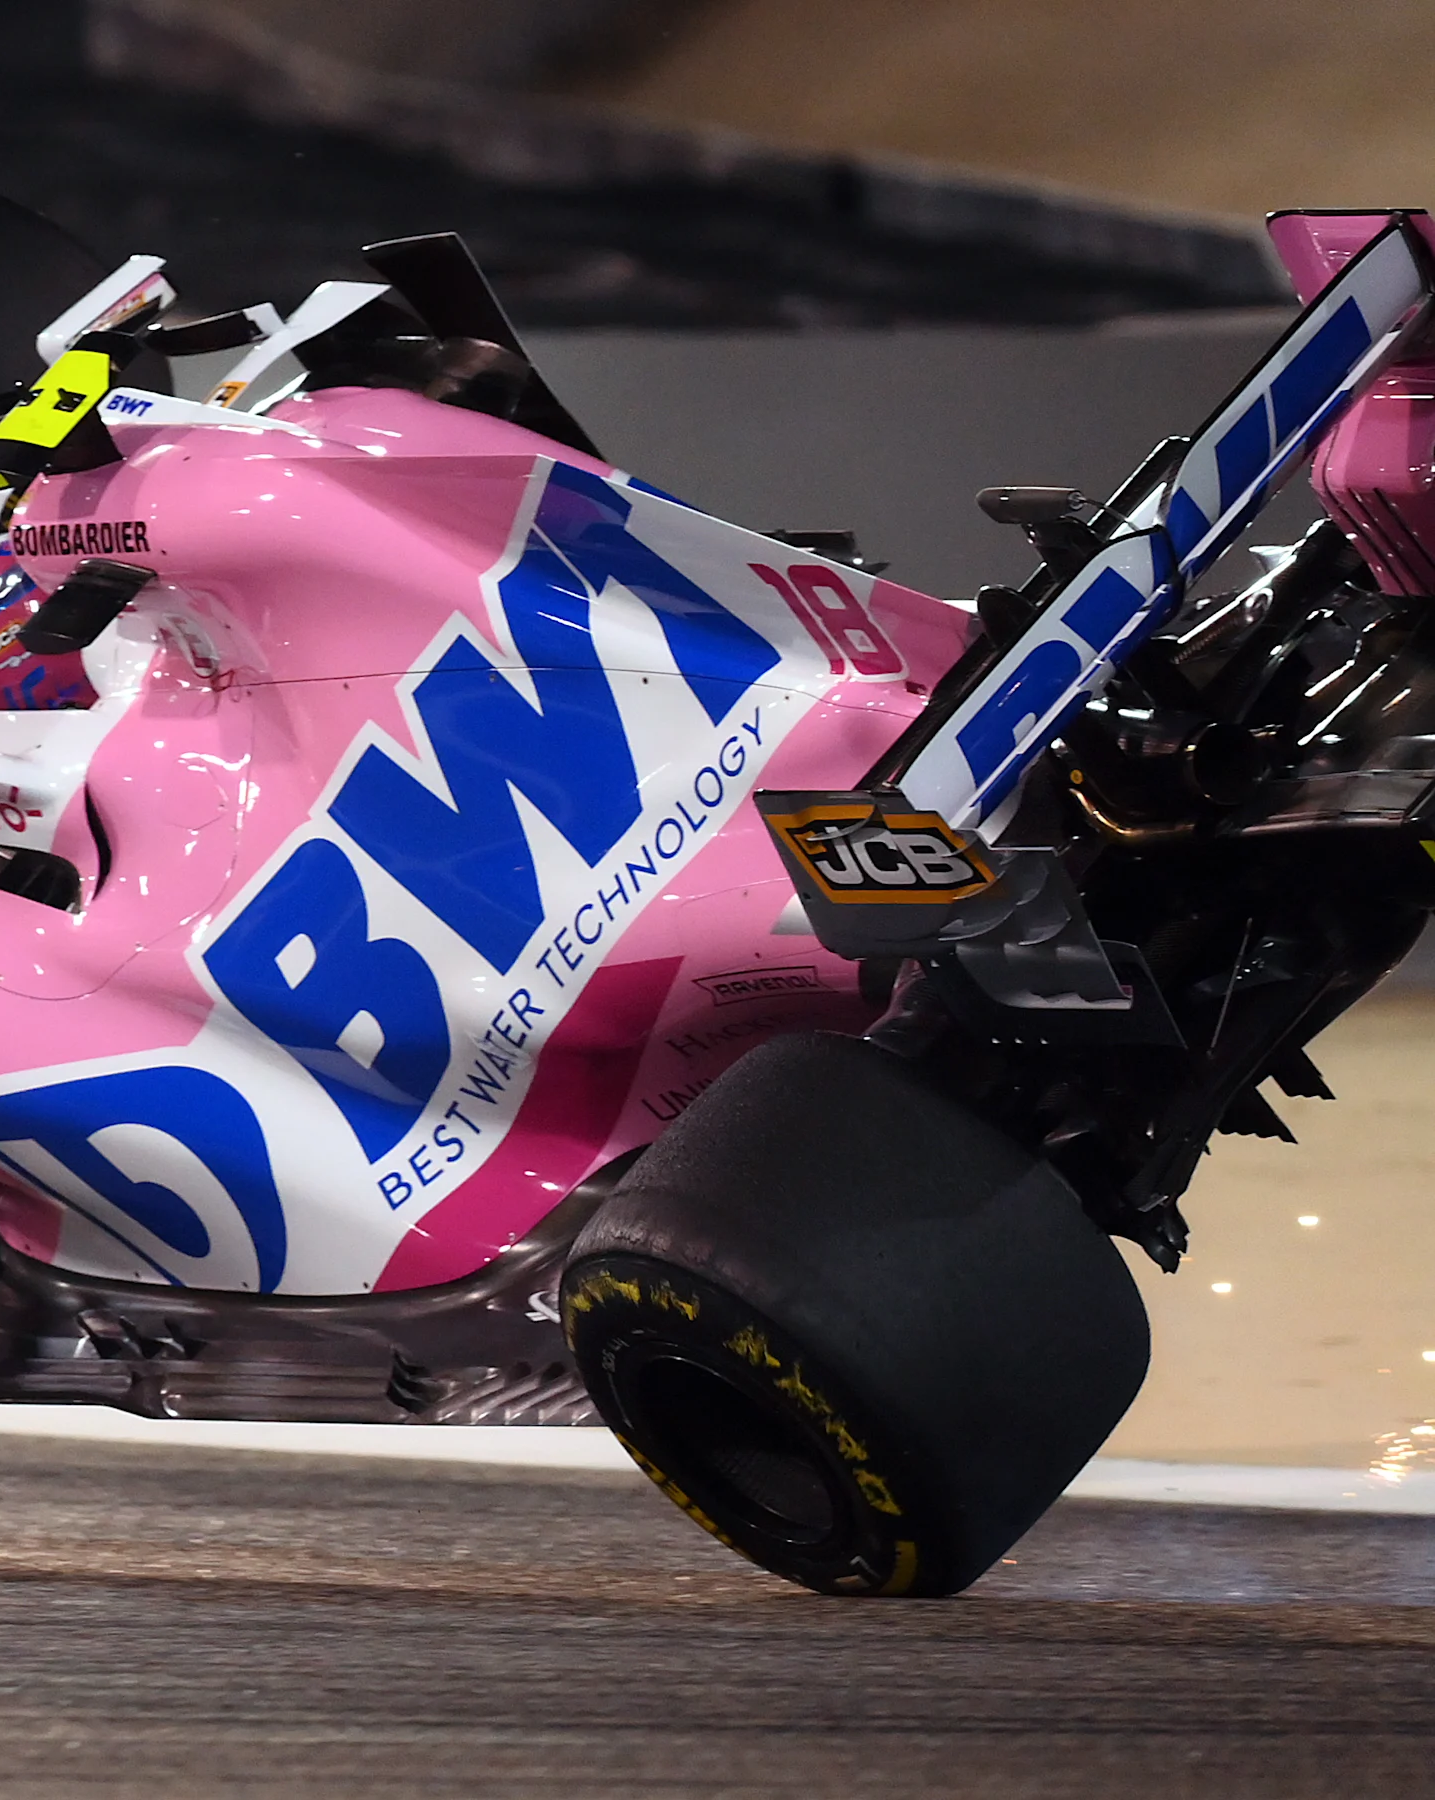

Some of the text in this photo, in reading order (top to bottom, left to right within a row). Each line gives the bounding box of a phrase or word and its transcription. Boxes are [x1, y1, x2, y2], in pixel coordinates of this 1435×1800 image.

[106, 393, 153, 417] BWT
[13, 520, 151, 557] BOMBARDIER
[747, 563, 903, 676] 18
[200, 460, 783, 1165] BWT
[813, 826, 974, 886] JCB
[377, 706, 765, 1211] BEST WATER TECHNOLOGY
[714, 975, 820, 998] RAVENOL
